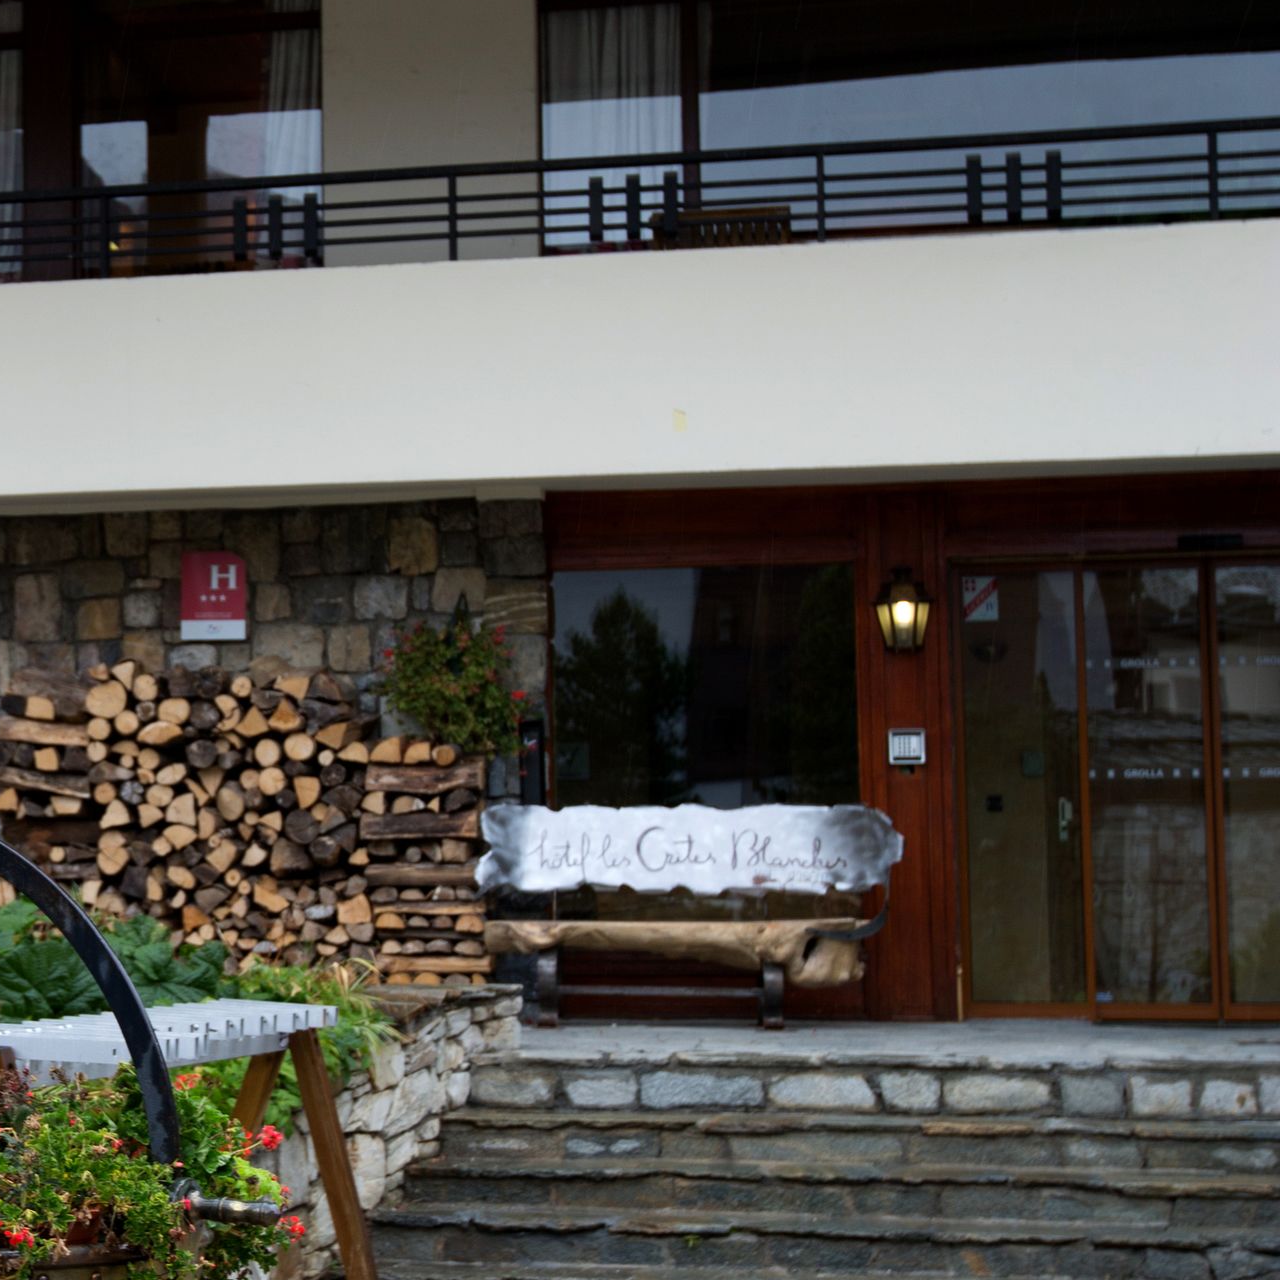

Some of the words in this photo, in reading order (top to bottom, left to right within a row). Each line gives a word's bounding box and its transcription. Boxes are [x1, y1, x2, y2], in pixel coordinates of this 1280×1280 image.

[210, 564, 237, 590] H
[1120, 658, 1160, 669] GROLLA
[1123, 768, 1164, 779] GROLLA
[730, 829, 848, 871] Blanches
